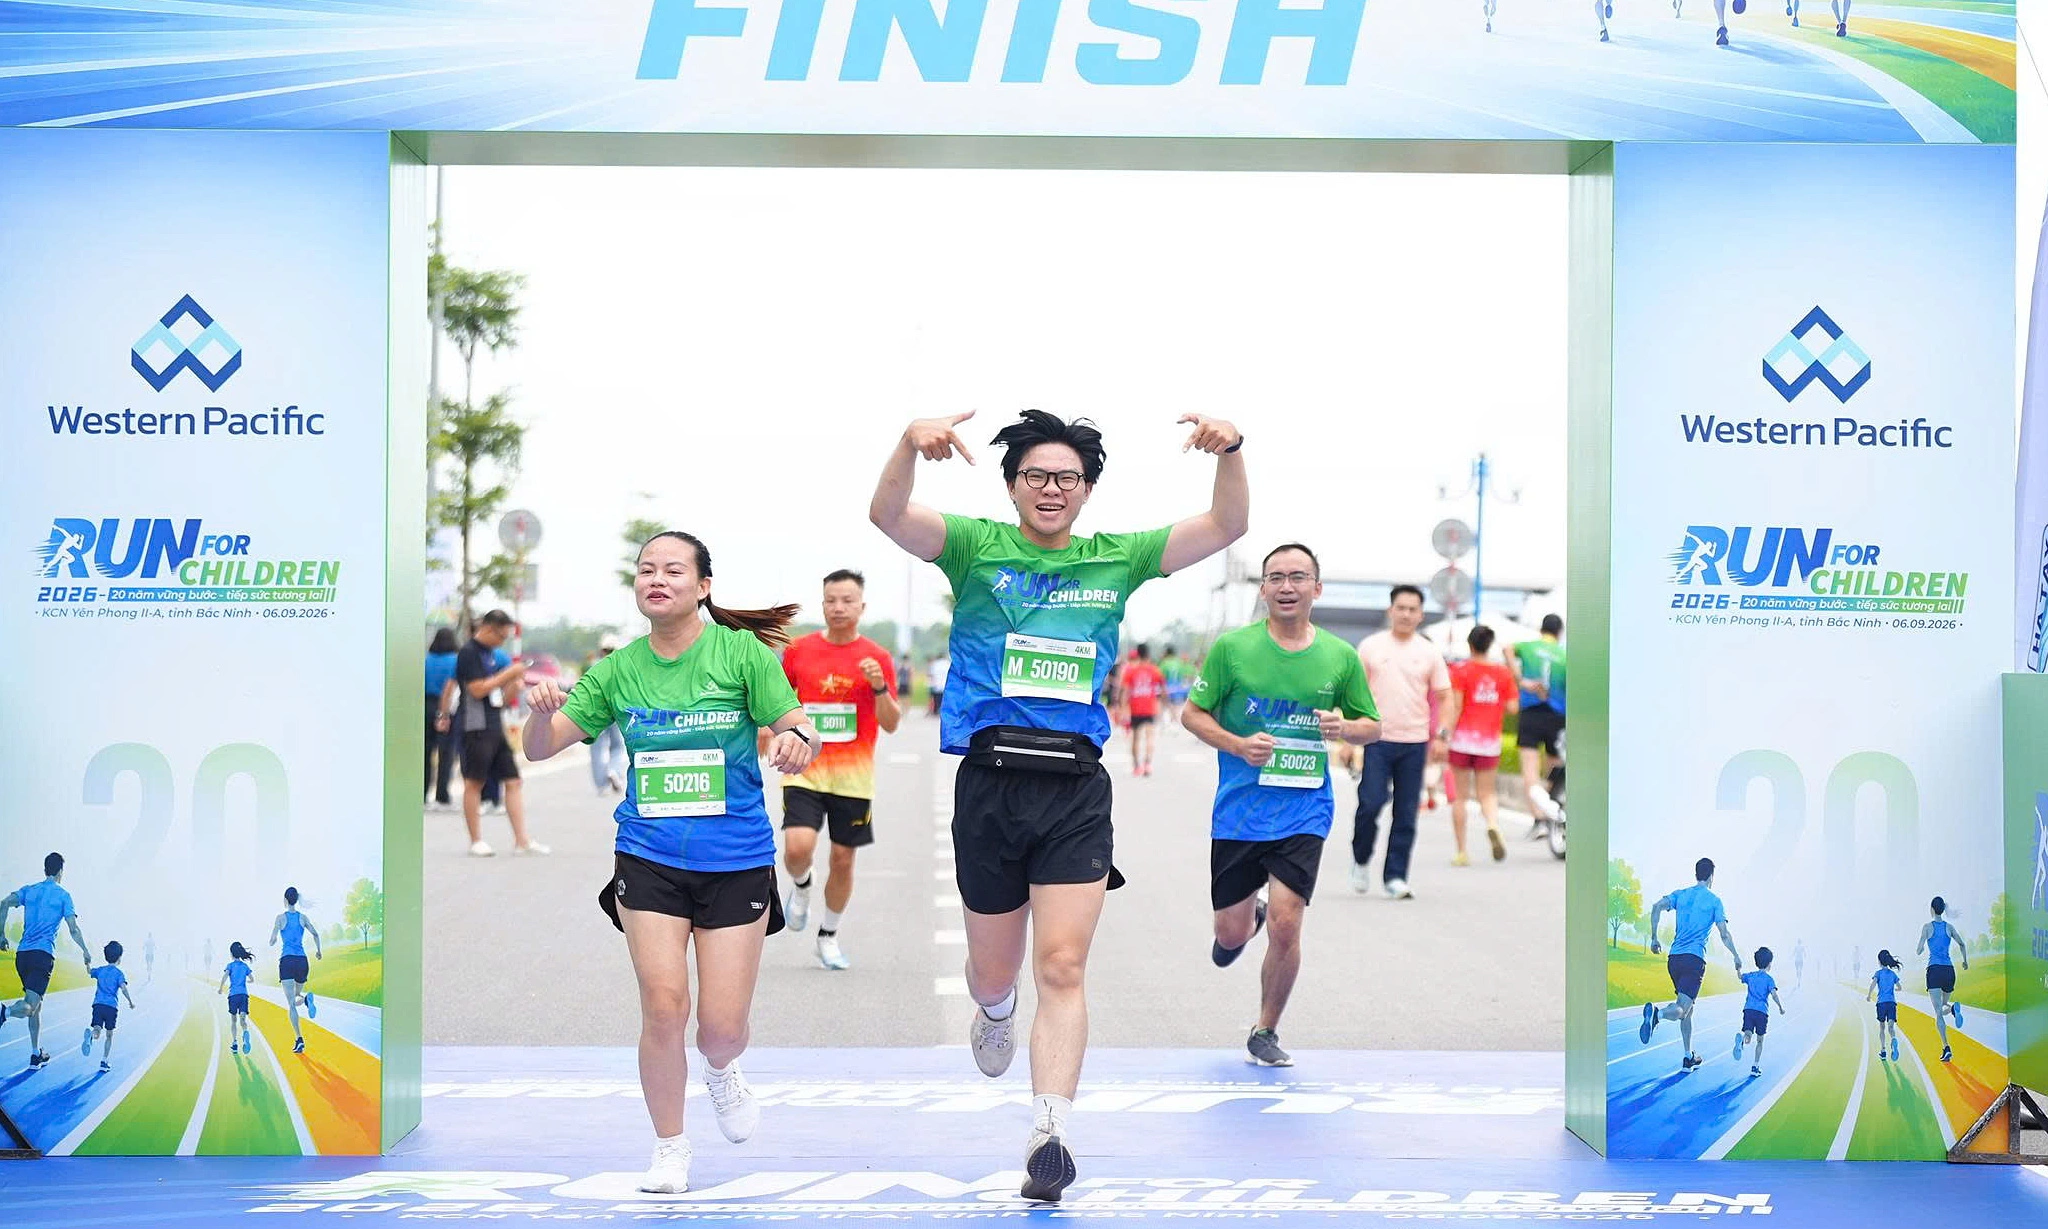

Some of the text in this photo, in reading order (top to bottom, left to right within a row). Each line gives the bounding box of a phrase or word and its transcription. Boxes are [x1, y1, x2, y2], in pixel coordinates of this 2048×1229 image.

[635, 0, 1367, 86] FINISH
[47, 405, 325, 435] Western Pacific
[1681, 414, 1953, 448] Western Pacific
[36, 518, 202, 579] RUN
[200, 535, 251, 556] FOR
[1670, 525, 1833, 587] RUN
[1830, 545, 1881, 566] FOR
[179, 560, 341, 586] CHILDREN
[1810, 569, 1969, 598] CHILDREN
[111, 590, 126, 600] 20
[309, 589, 323, 600] lai
[1048, 589, 1119, 603] CHILDREN
[1743, 597, 1758, 608] 20
[1937, 601, 1952, 611] lai
[42, 608, 68, 618] KCN
[98, 608, 137, 620] Phong
[223, 608, 252, 618] Ninh
[262, 608, 328, 618] 06.09.2026
[1675, 614, 1702, 624] KCN
[1730, 615, 1770, 628] Phong
[1853, 617, 1882, 628] Ninh
[1892, 618, 1957, 629] 06.09.2026
[1007, 656, 1080, 683] M 50190
[674, 711, 741, 728] CHILDREN
[1288, 713, 1320, 726] CHILD
[1280, 754, 1317, 771] 50023
[641, 772, 711, 794] F 50216
[240, 1170, 1032, 1201] RUN
[1073, 1177, 1320, 1189] FOR
[975, 1188, 1771, 1207] CHILDREN
